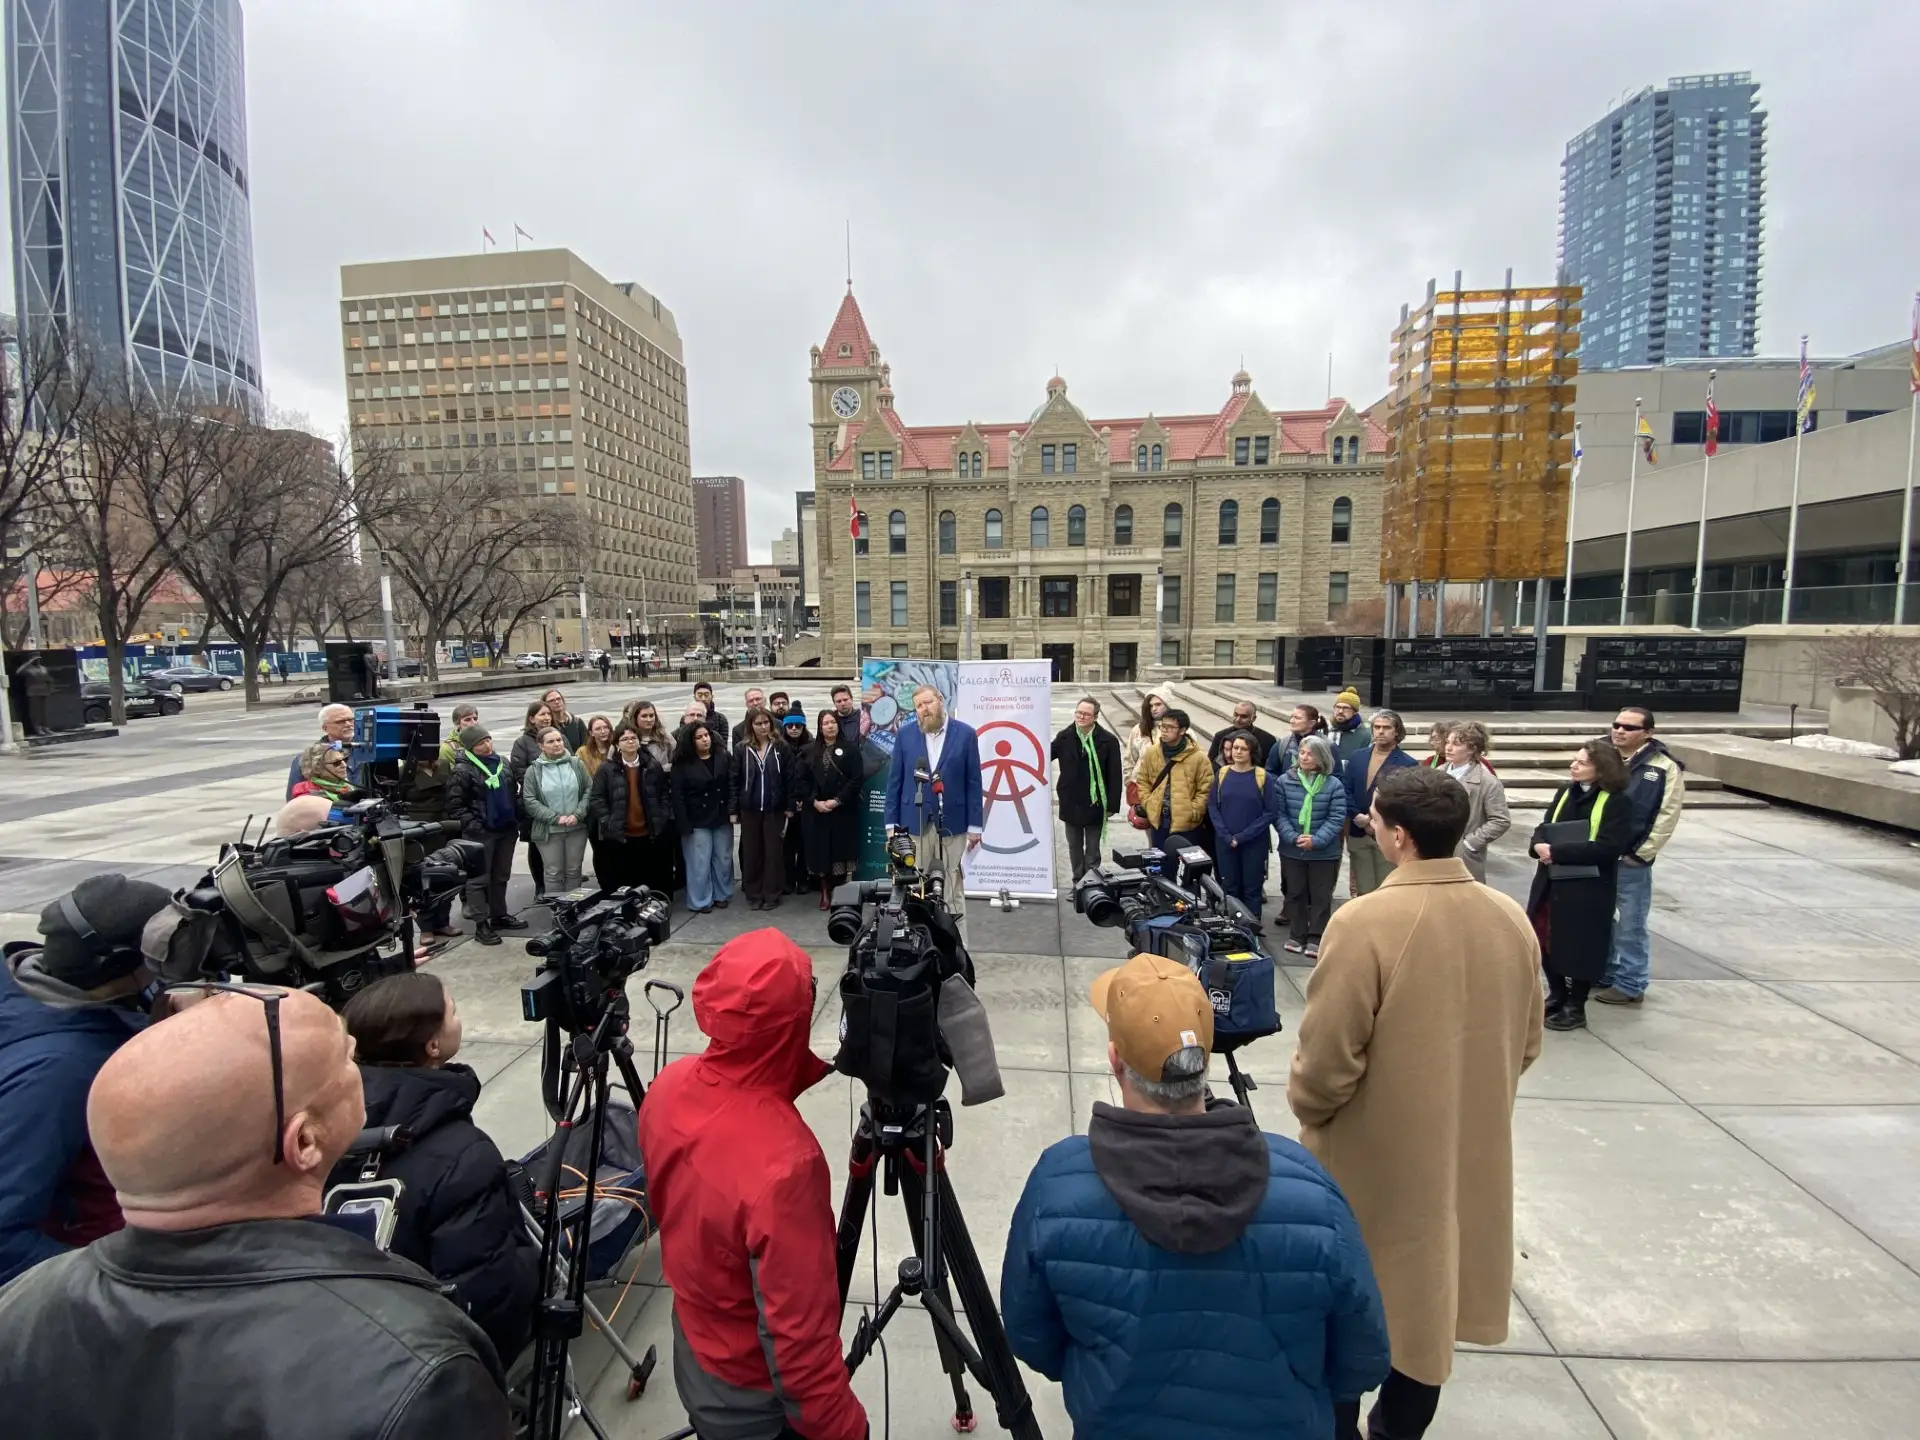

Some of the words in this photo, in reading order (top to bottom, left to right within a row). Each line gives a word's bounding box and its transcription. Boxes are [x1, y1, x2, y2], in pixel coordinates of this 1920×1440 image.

[959, 676, 1000, 686] CALGARY
[986, 703, 1014, 711] COMMON
[971, 864, 1049, 872] @CALGARYCOMMONGOOD.ORG
